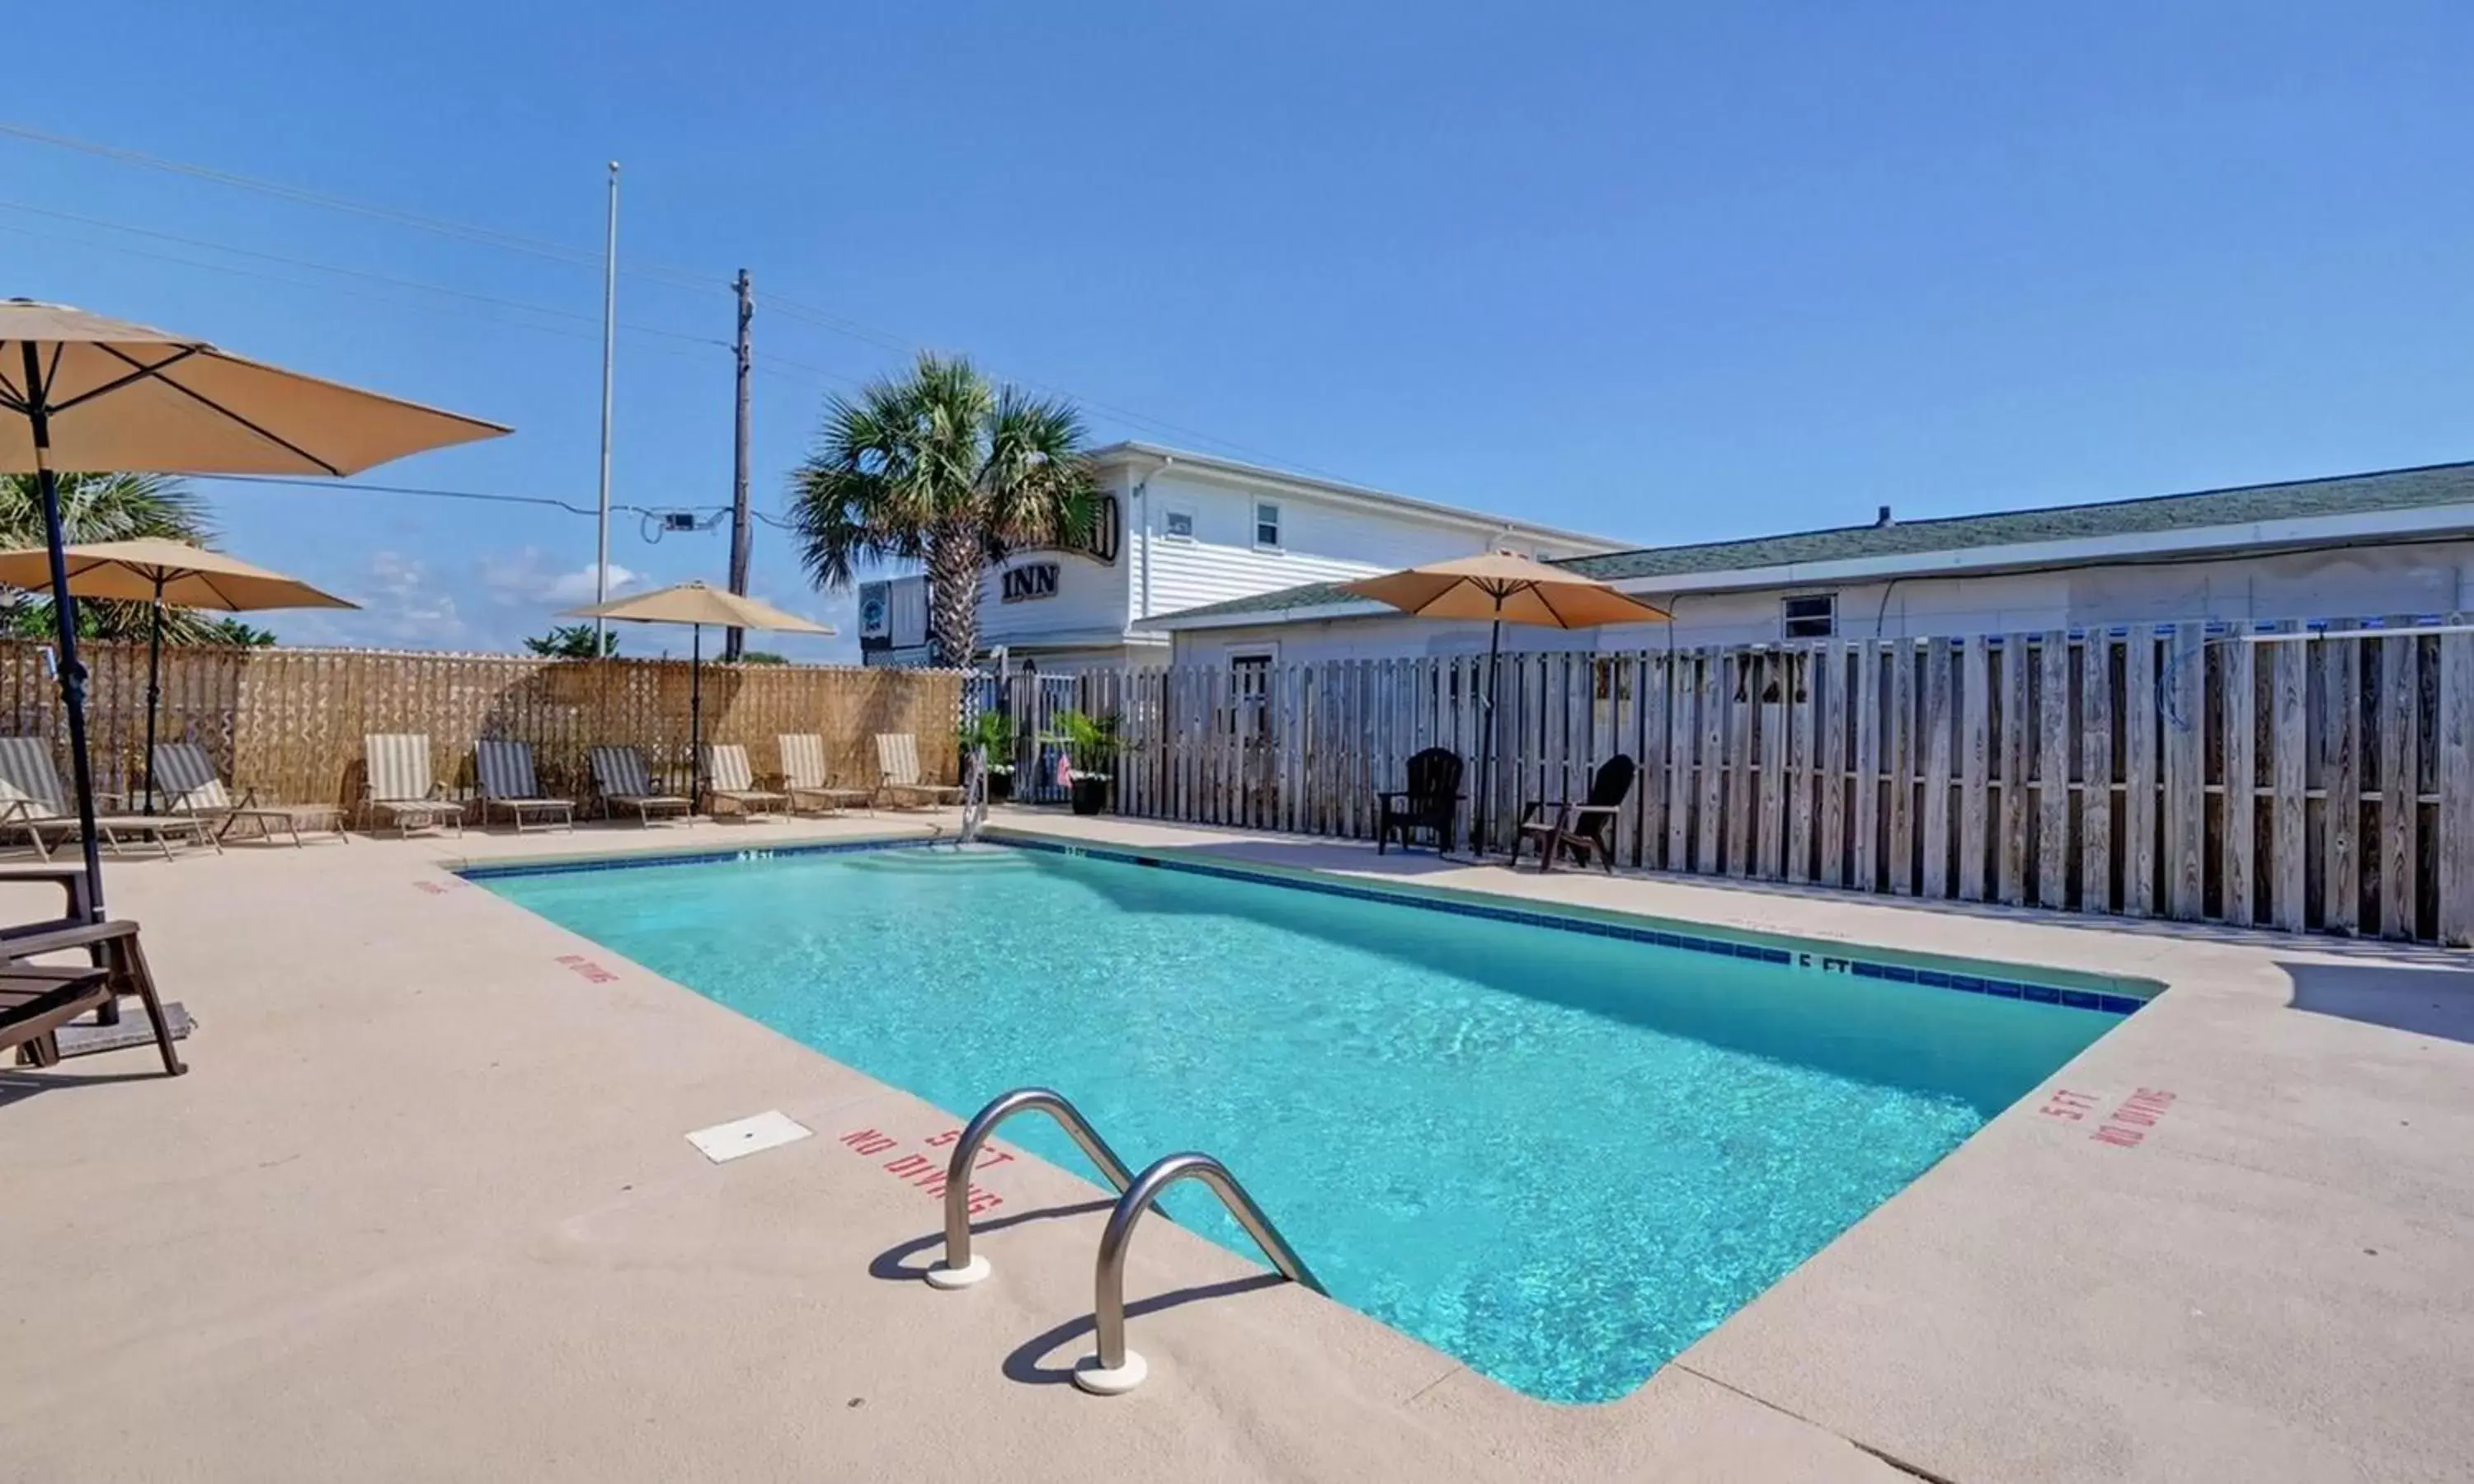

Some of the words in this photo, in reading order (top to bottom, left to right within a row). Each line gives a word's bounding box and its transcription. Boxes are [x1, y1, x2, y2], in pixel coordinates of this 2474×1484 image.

[1001, 564, 1059, 601] INN
[1823, 956, 1850, 973] FT
[839, 1128, 898, 1156] NO
[924, 1129, 962, 1148] 5
